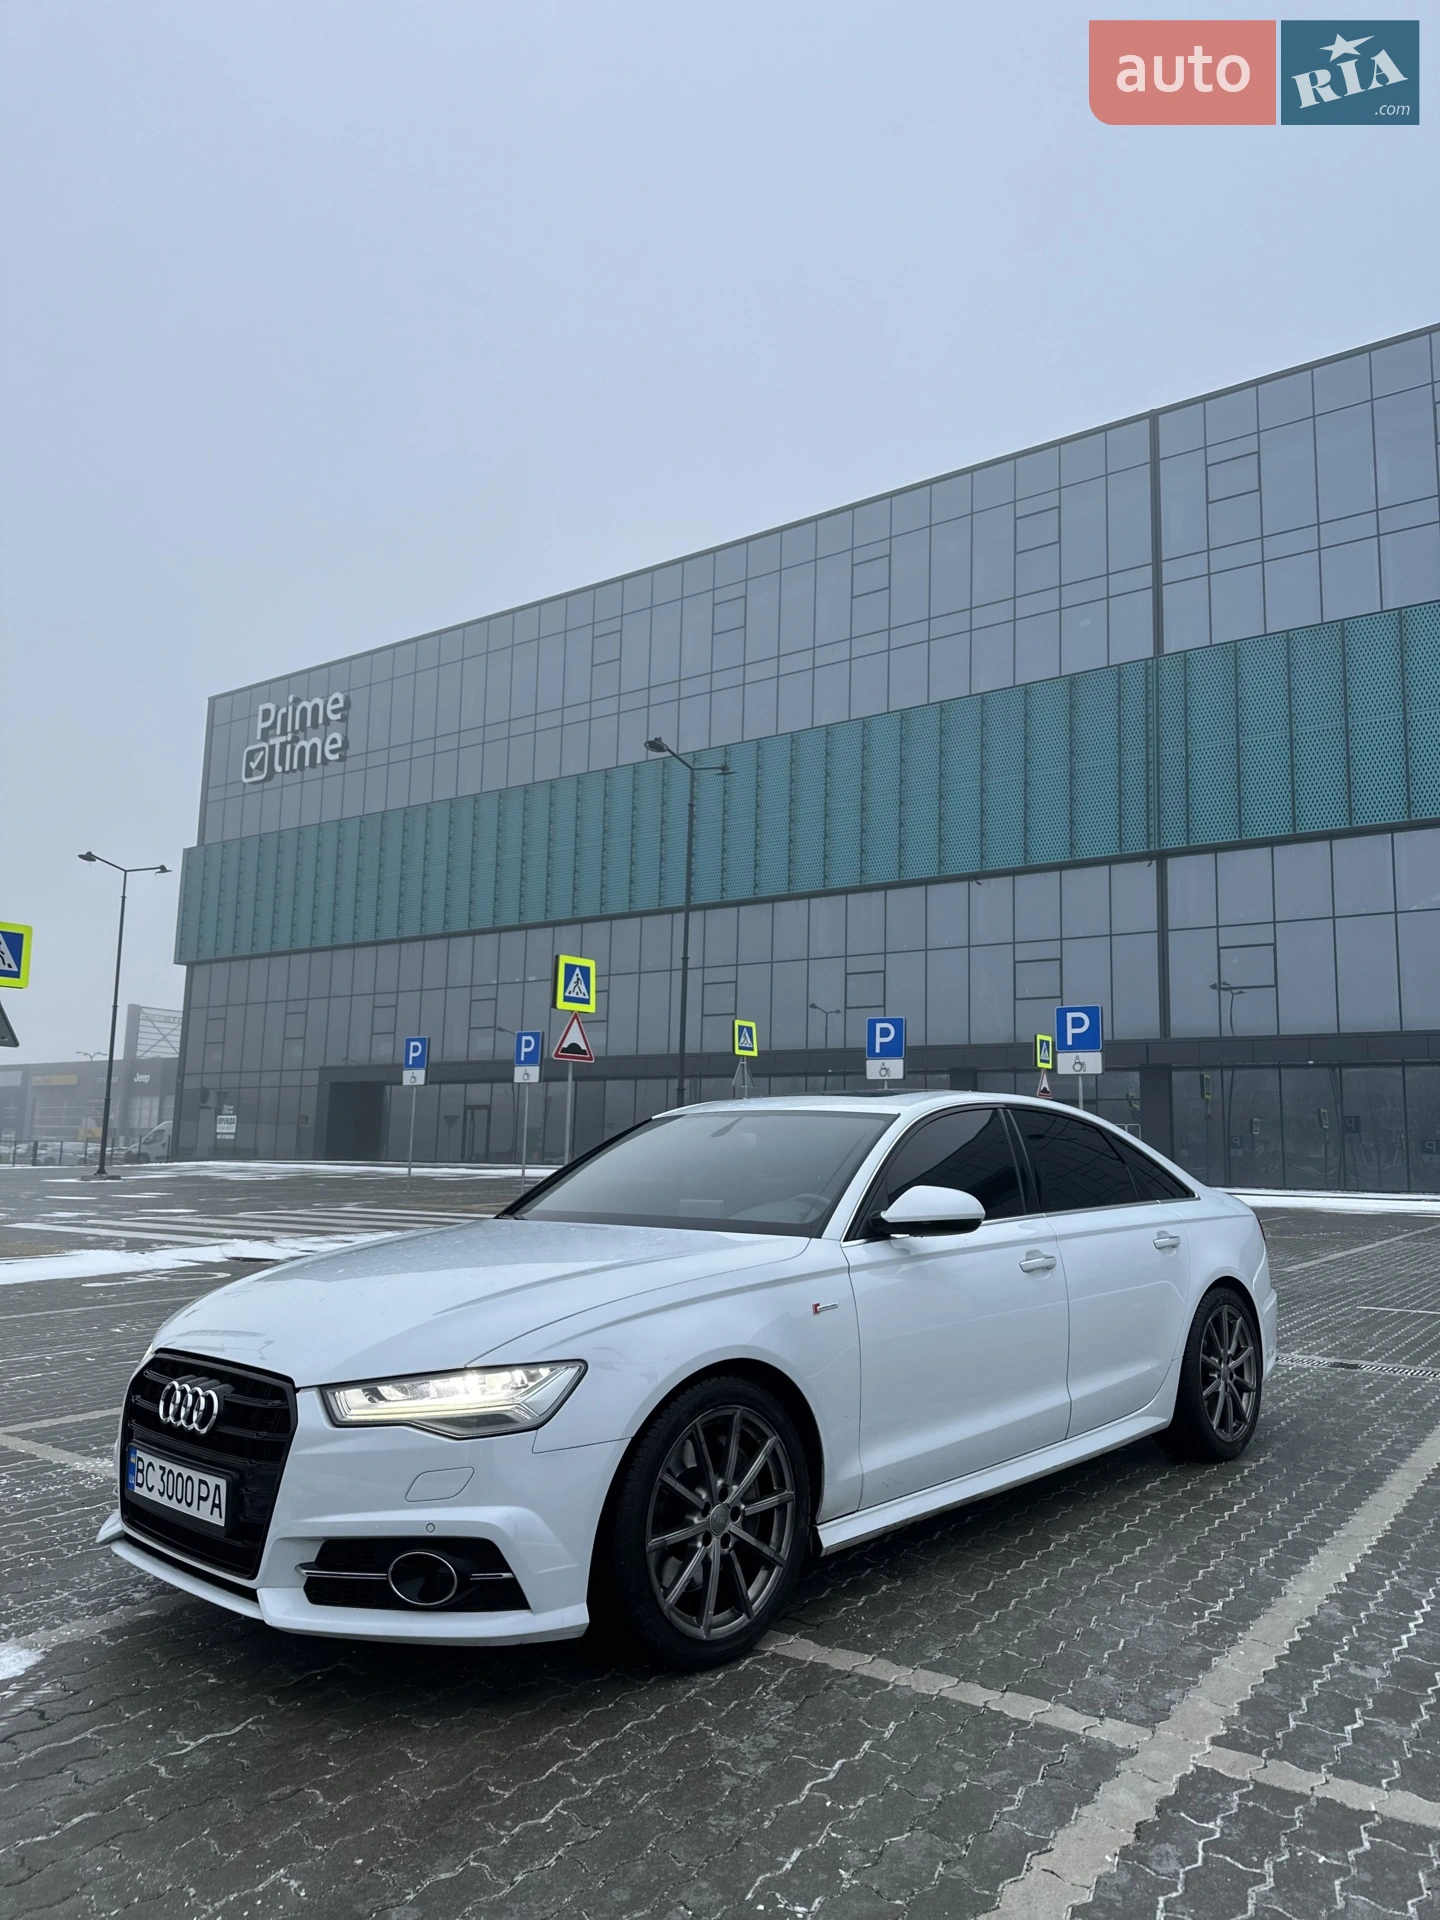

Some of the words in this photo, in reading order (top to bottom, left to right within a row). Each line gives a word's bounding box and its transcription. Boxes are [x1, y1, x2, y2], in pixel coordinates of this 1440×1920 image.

[257, 692, 344, 740] Prime
[268, 732, 342, 773] Time
[875, 1022, 895, 1053] P
[1066, 1012, 1090, 1046] P
[408, 1041, 422, 1065] P
[520, 1035, 535, 1061] P
[133, 1072, 150, 1084] Jeep
